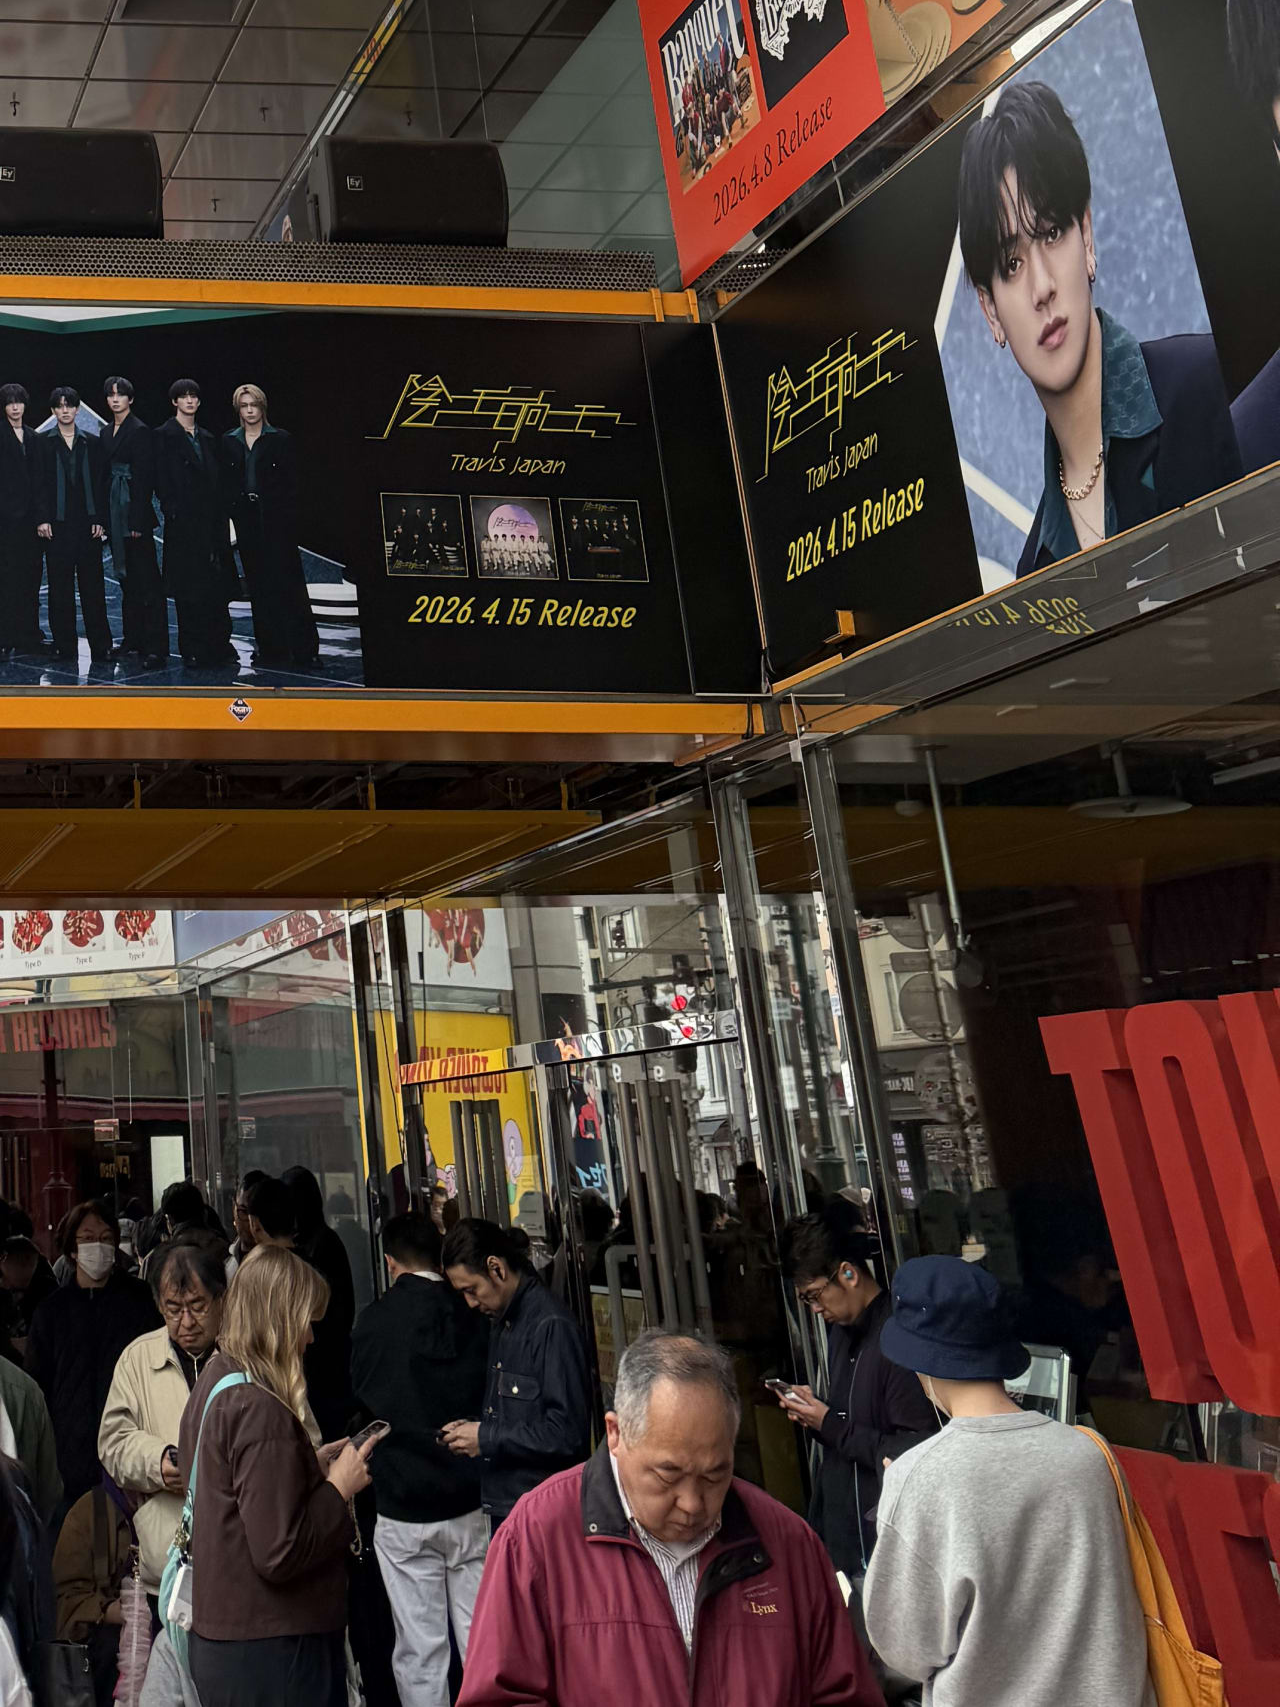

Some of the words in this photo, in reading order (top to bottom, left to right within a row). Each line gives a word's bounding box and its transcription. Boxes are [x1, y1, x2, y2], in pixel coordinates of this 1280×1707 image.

[713, 143, 773, 225] 2026.4.8
[776, 96, 833, 167] Release
[451, 453, 506, 472] Travis
[509, 456, 566, 476] Japan
[806, 455, 840, 494] Travis
[843, 432, 878, 476] Japan
[786, 526, 824, 582] 2026.
[826, 517, 839, 557] 4.
[842, 506, 857, 552] 15
[861, 477, 925, 541] Release
[408, 595, 475, 624] 2026.
[481, 597, 500, 625] 4.
[506, 597, 535, 626] 15
[538, 598, 637, 628] Release
[12, 1007, 117, 1053] RECORDS
[750, 1601, 778, 1616] Lynx
